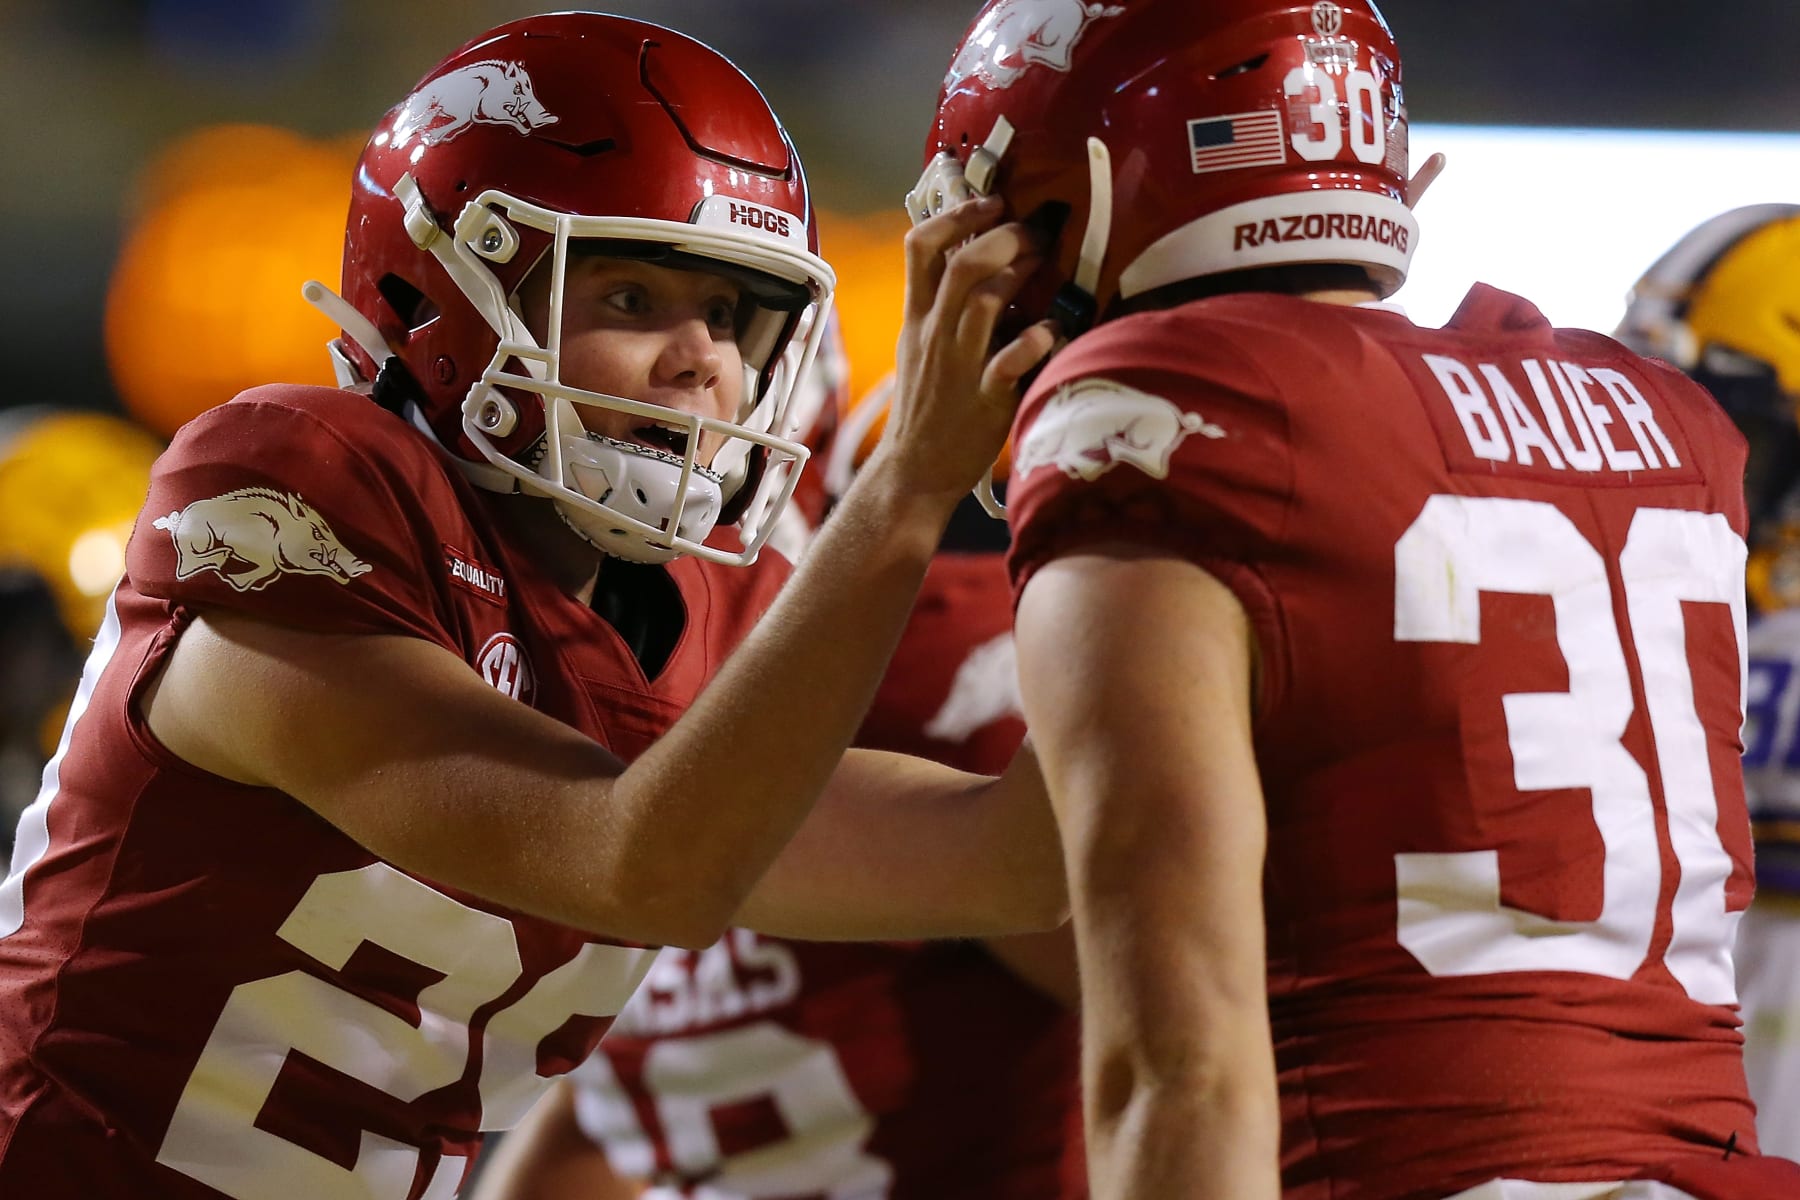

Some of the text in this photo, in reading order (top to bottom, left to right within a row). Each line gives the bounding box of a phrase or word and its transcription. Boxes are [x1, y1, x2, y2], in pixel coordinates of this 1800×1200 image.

[1315, 3, 1338, 33] SEC
[1283, 67, 1385, 165] 30
[729, 202, 790, 238] HOGS
[1233, 213, 1408, 255] RAZORBACKS
[1421, 353, 1681, 471] BAUER
[452, 558, 505, 597] EQUALITY
[1394, 494, 1749, 1006] 30
